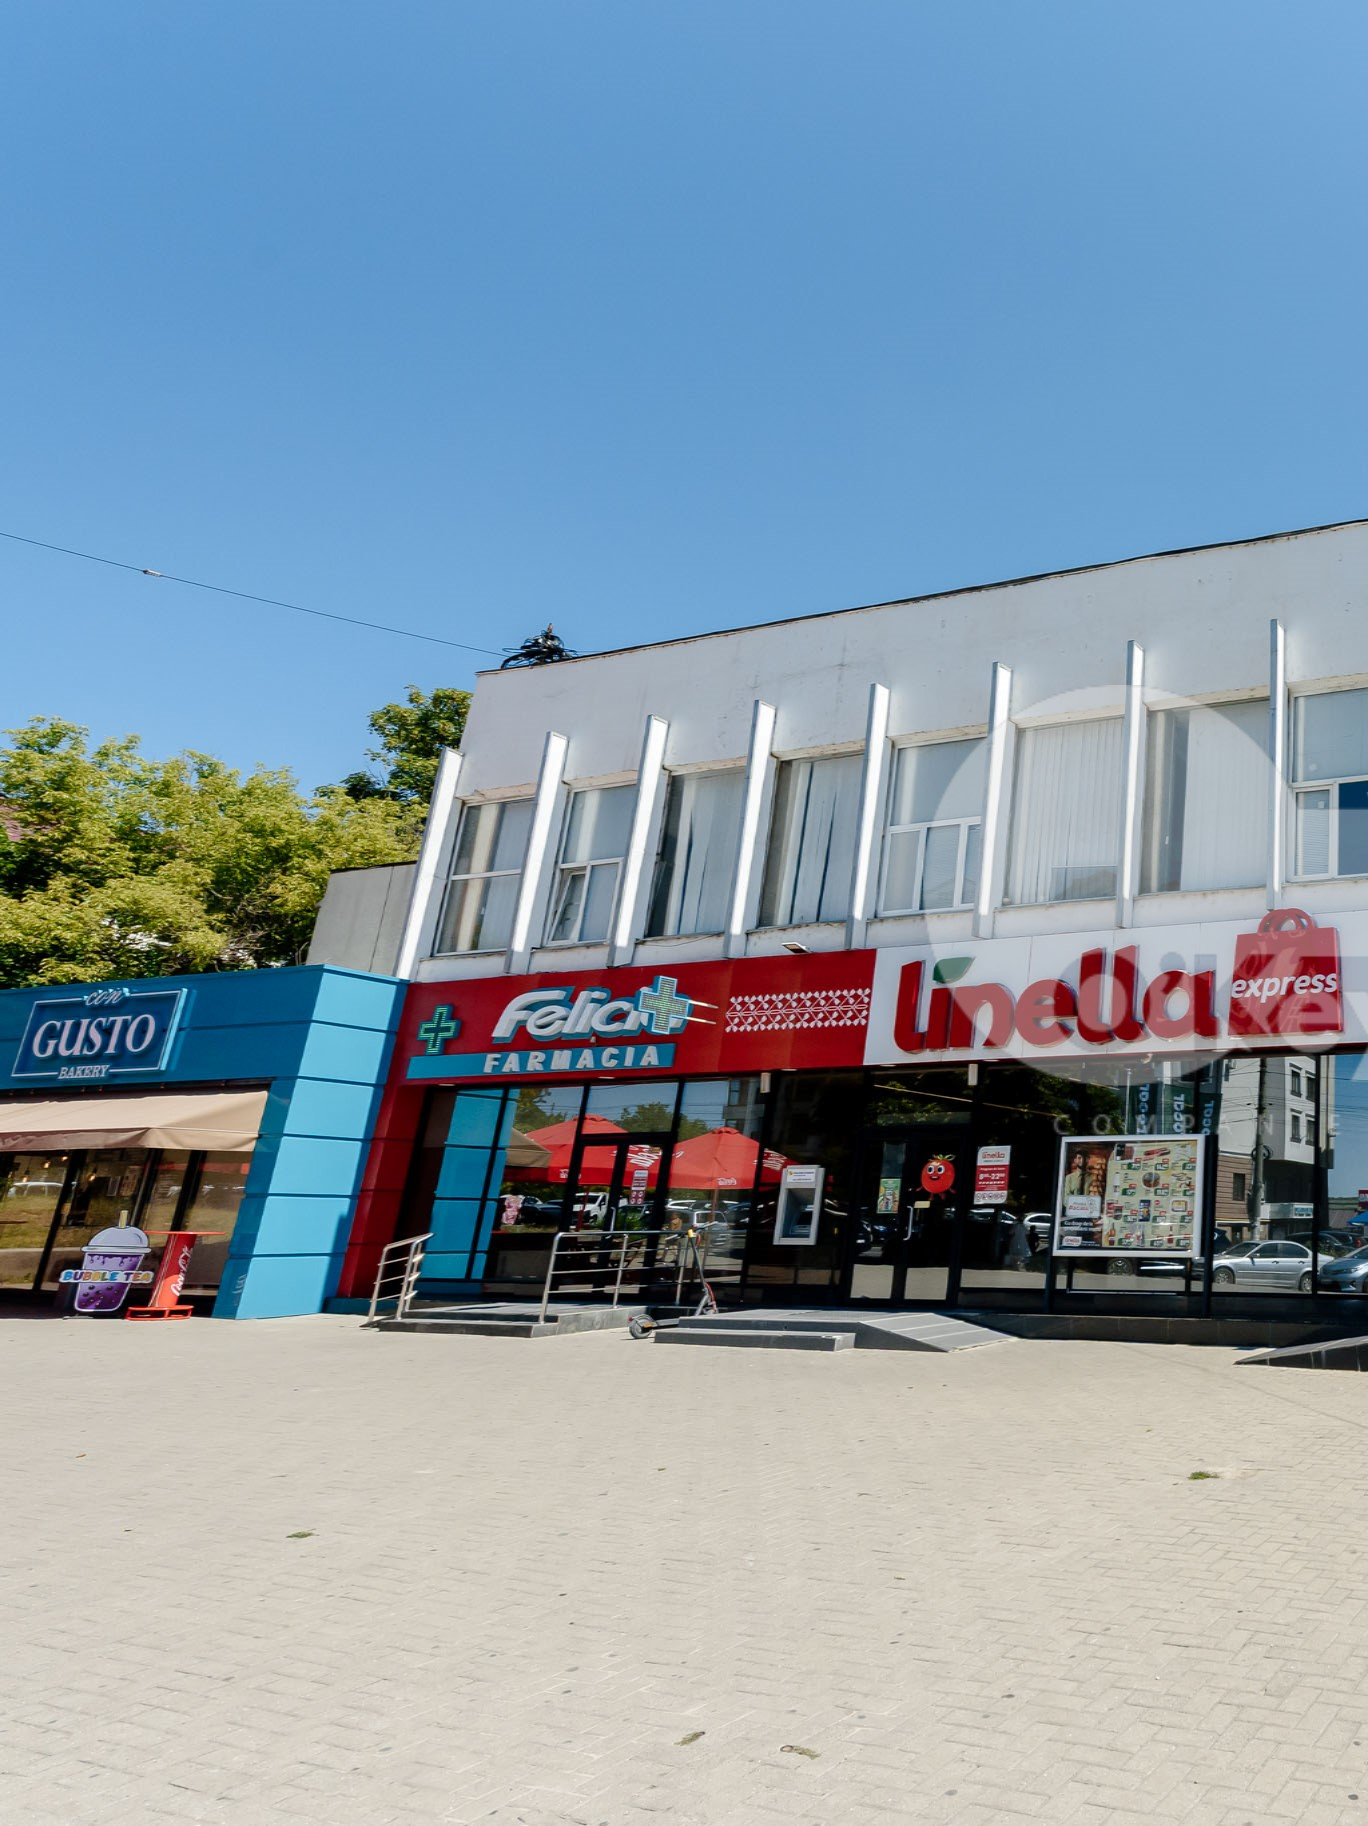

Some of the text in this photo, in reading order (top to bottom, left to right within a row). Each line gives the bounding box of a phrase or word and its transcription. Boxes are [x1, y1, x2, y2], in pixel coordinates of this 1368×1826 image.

[84, 988, 124, 1006] con
[893, 946, 1219, 1054] linella
[1231, 971, 1339, 1002] express
[32, 1013, 156, 1058] GUSTO
[58, 1064, 110, 1080] BAKERY
[483, 1045, 660, 1073] FARMACIA
[1172, 1093, 1185, 1135] OCAL
[61, 1270, 151, 1282] BUBBLE TEA
